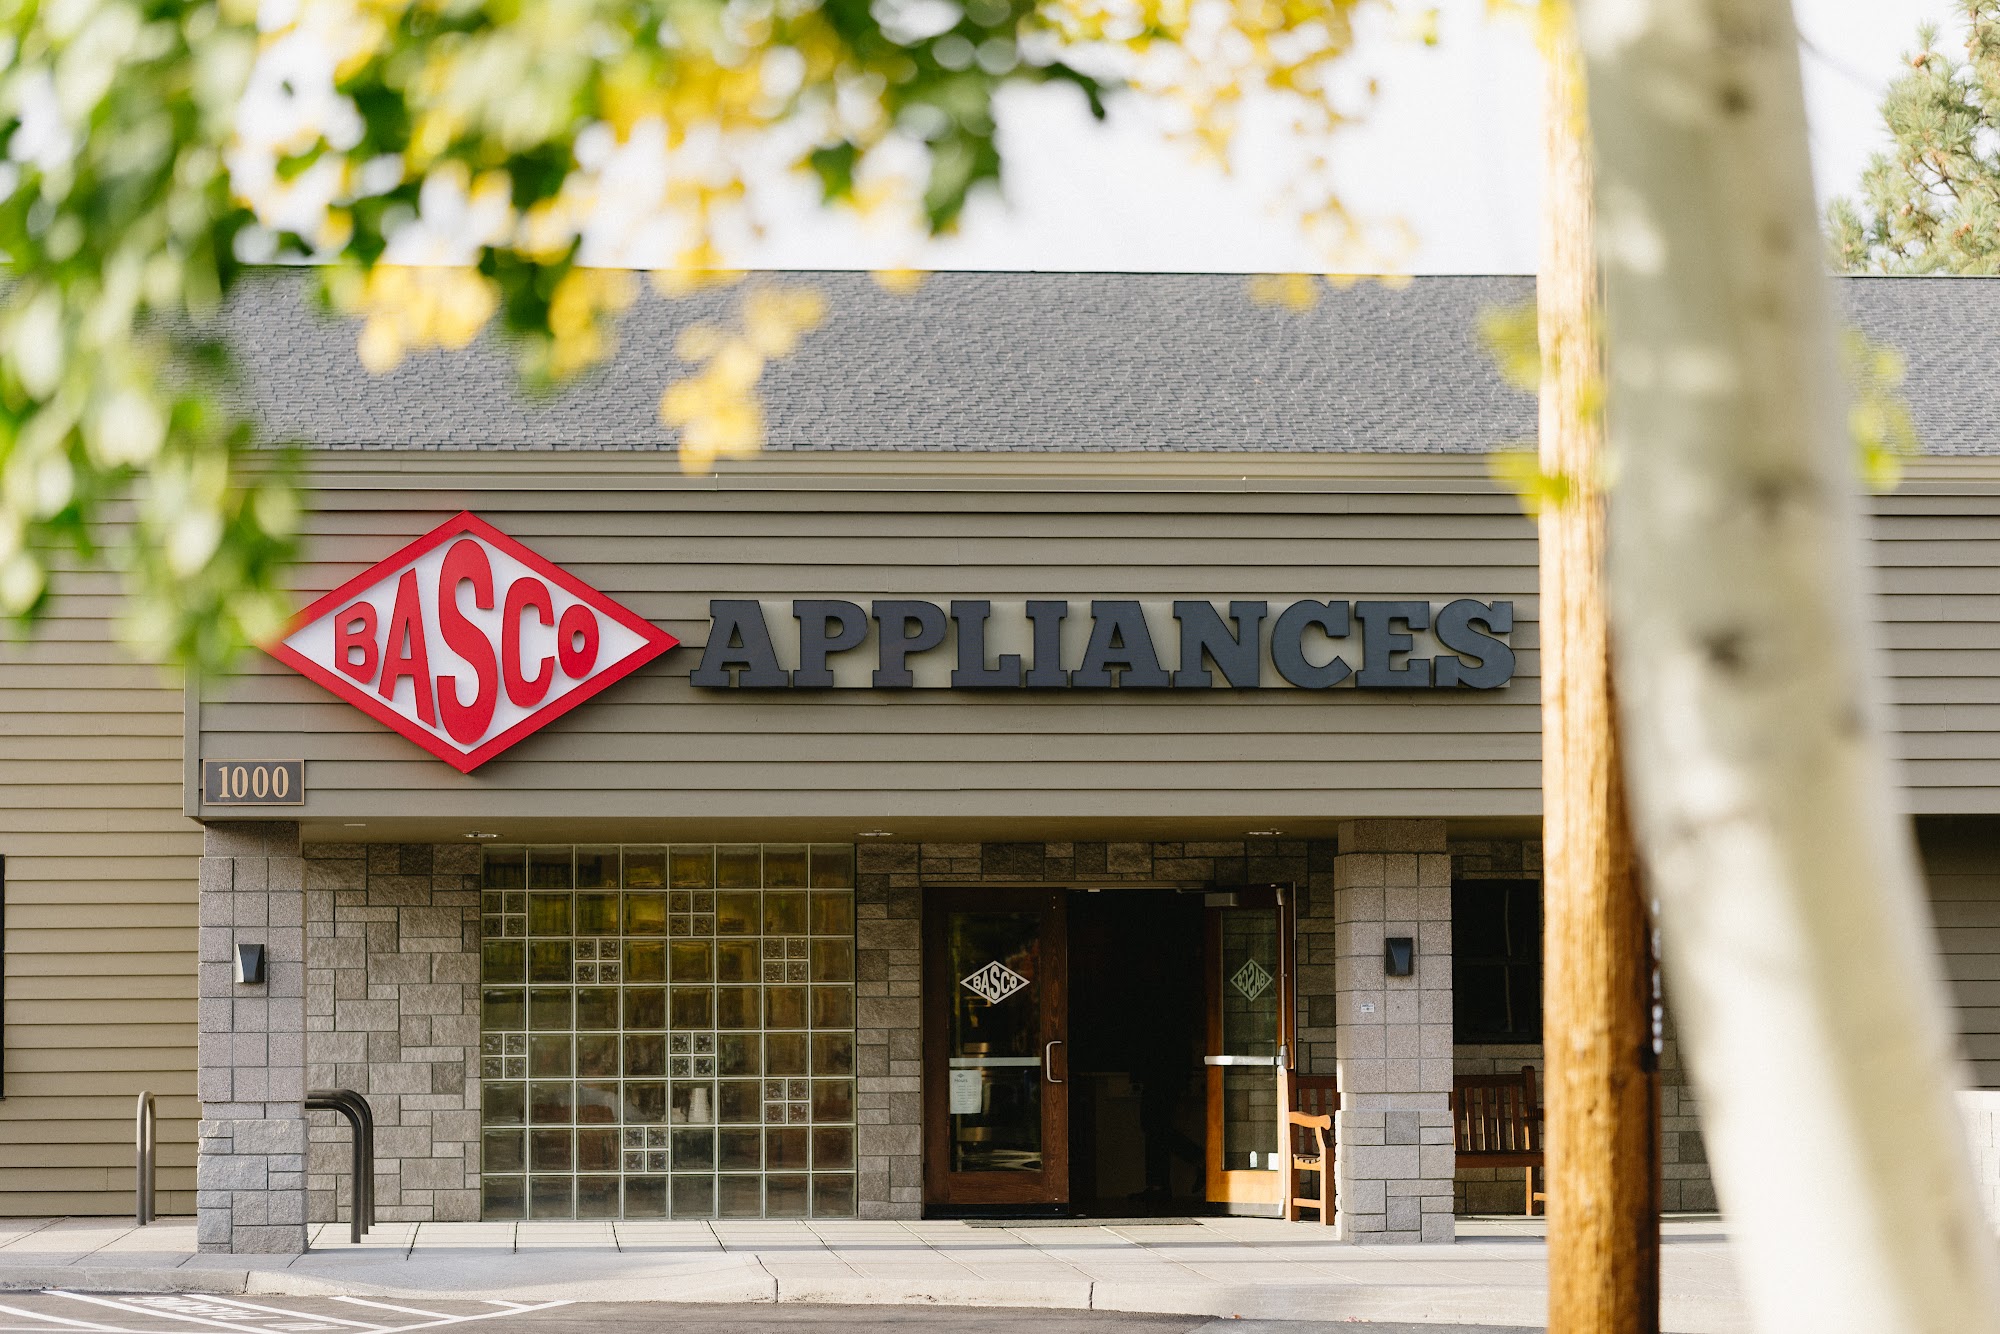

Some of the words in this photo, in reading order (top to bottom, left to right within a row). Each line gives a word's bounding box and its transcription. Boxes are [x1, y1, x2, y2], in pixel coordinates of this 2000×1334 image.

[334, 538, 600, 745] BASCO
[688, 598, 1517, 690] APPLIANCES
[218, 766, 289, 798] 1000
[973, 964, 1018, 1000] BASCO
